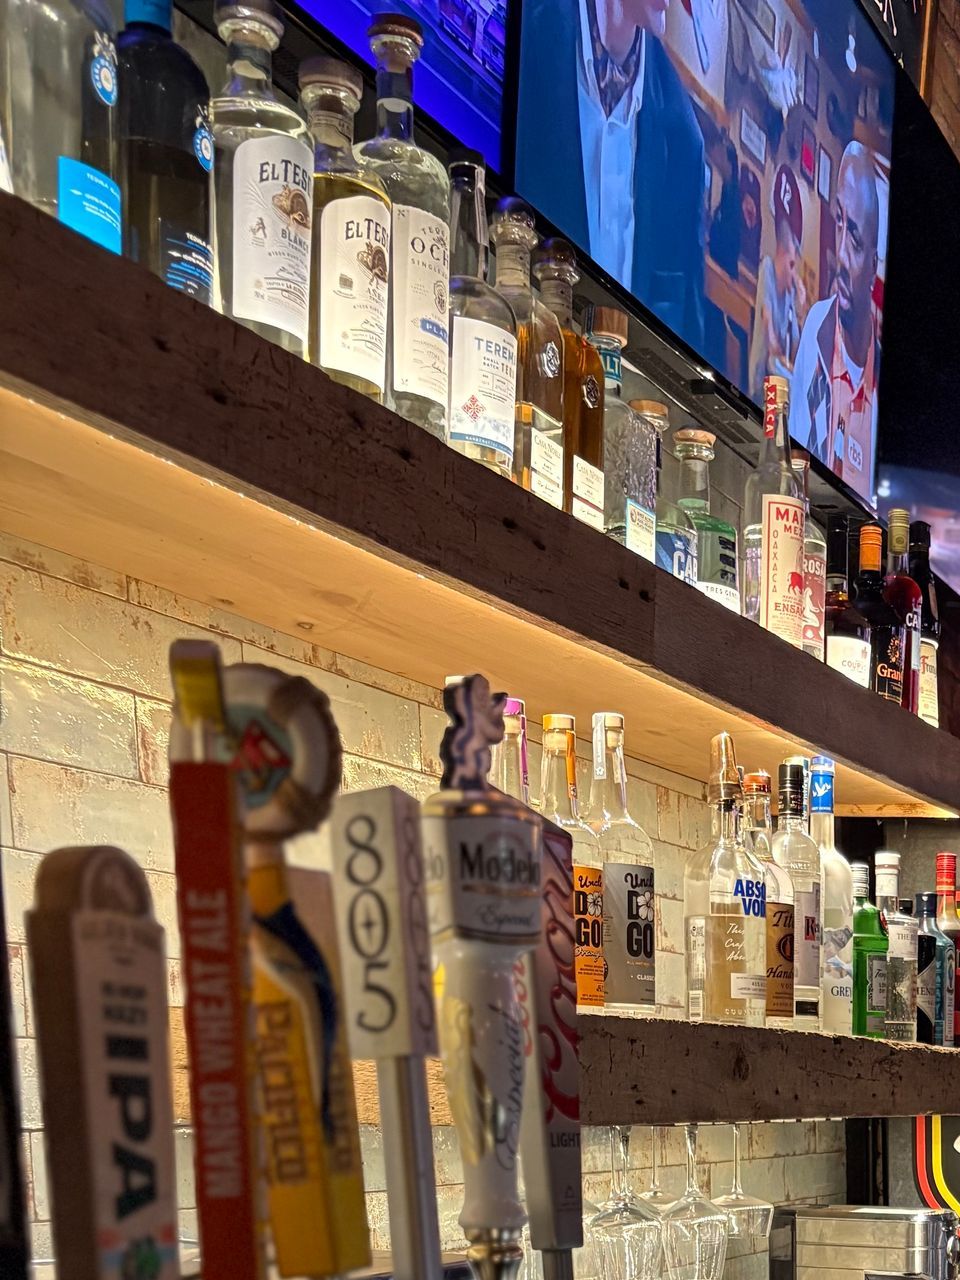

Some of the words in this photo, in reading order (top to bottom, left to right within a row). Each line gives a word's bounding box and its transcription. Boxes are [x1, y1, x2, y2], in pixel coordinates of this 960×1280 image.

[458, 840, 542, 888] Modelo
[187, 888, 229, 950] ALE
[191, 957, 237, 1078] WHEAT
[105, 1034, 158, 1222] IPA
[200, 1080, 242, 1199] MANGO
[549, 1131, 580, 1149] LIGHT
